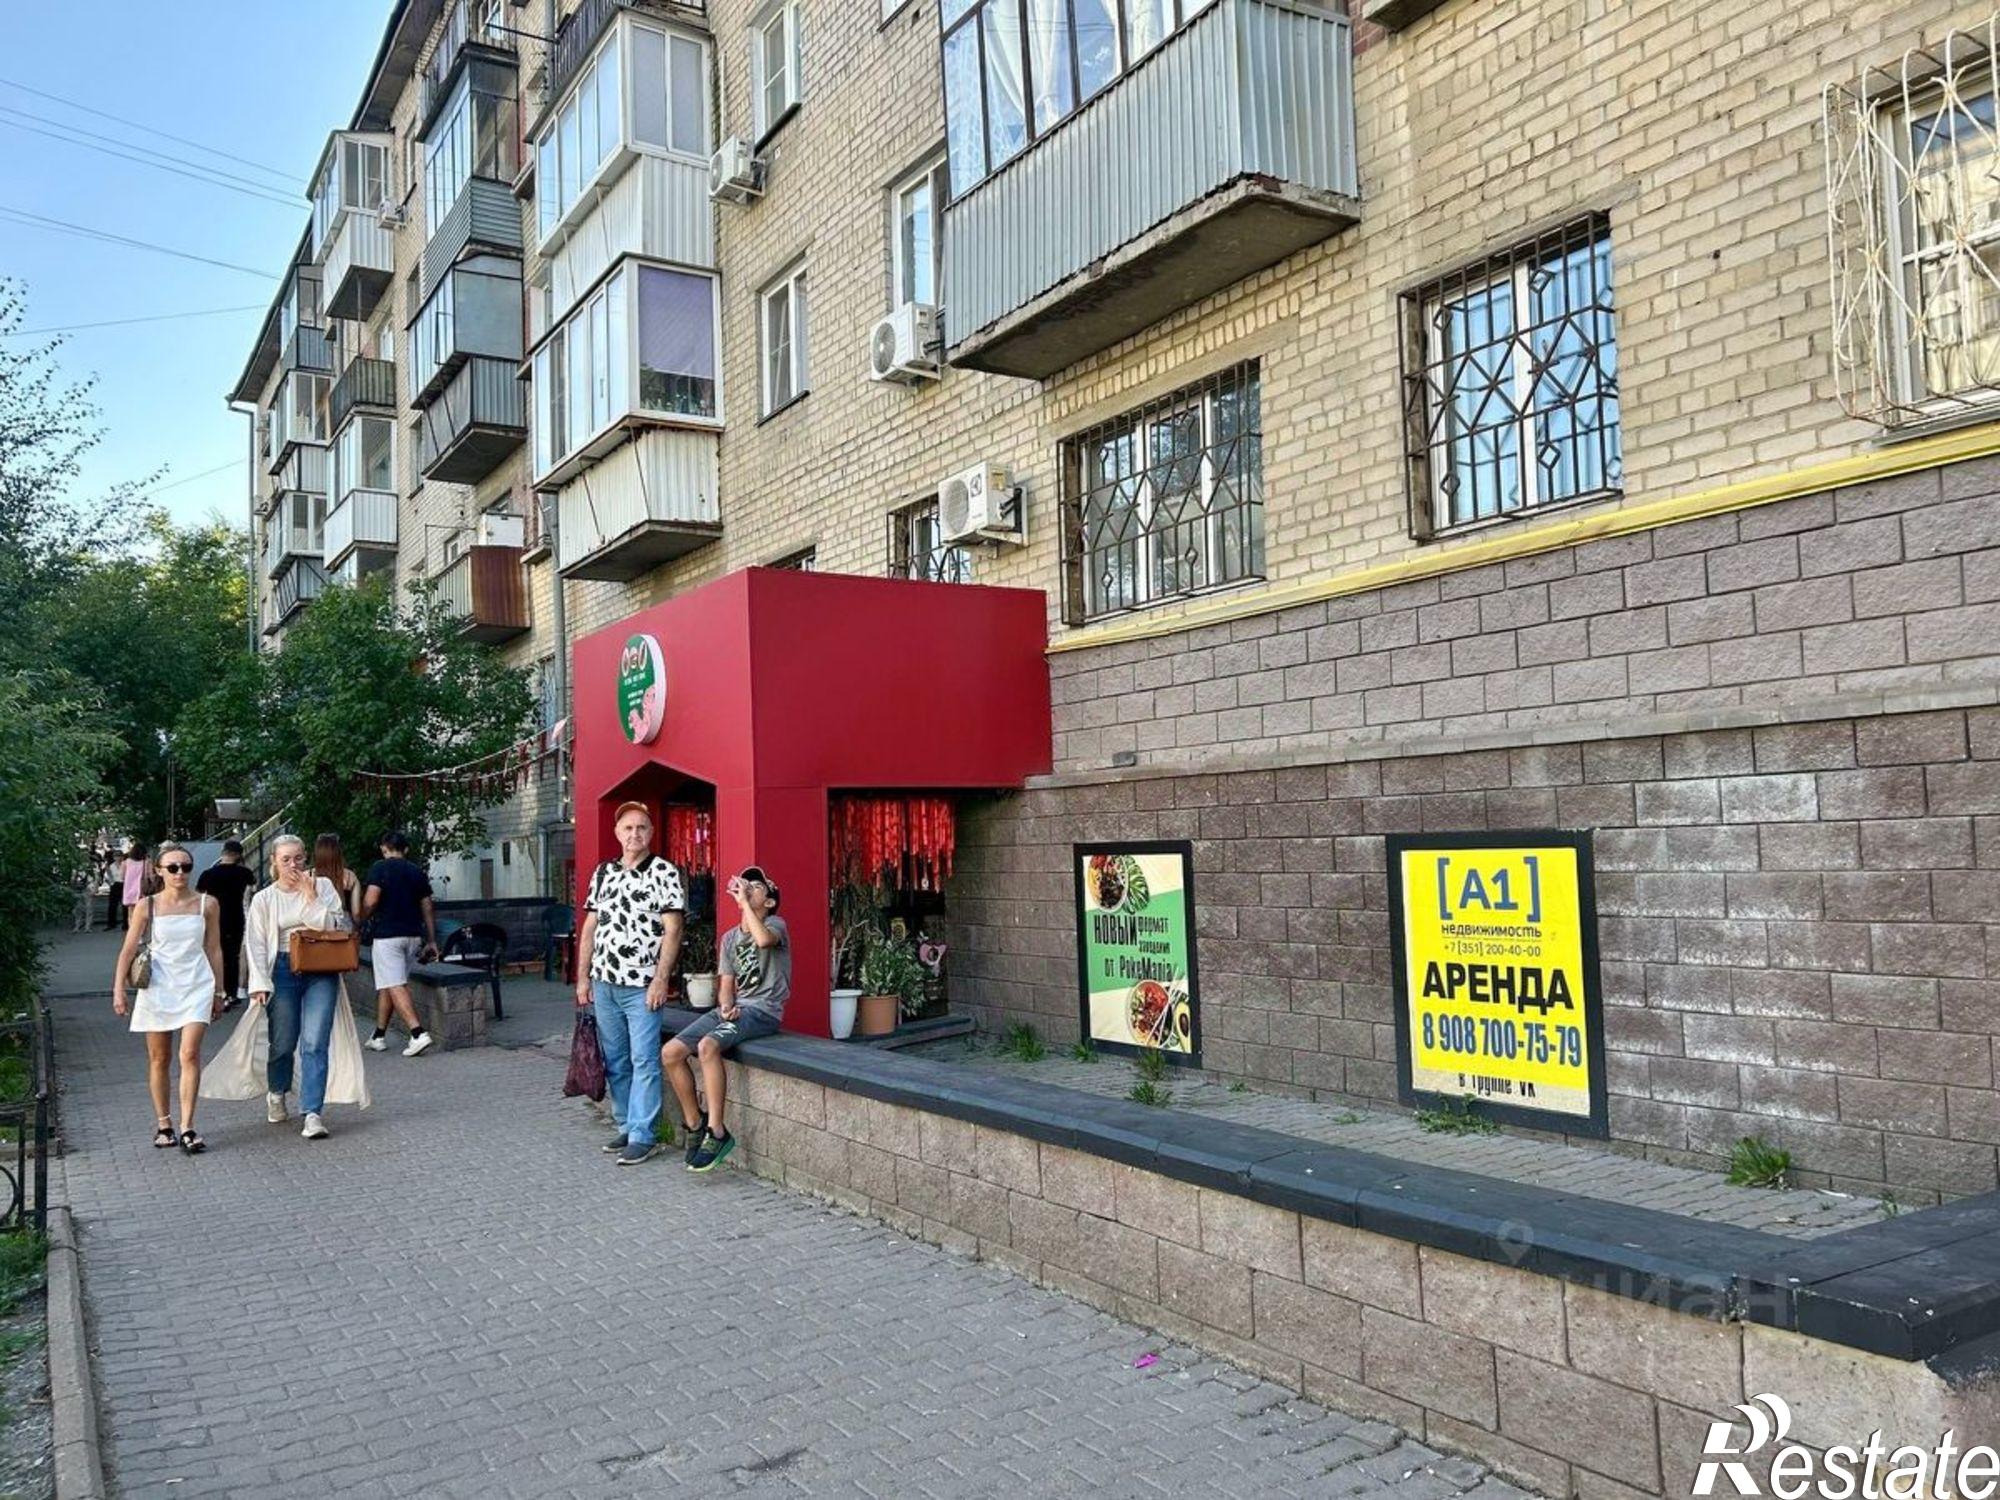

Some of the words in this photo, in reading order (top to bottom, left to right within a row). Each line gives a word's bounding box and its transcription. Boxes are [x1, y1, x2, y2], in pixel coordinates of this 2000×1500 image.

[1441, 924, 1542, 938] недвижимость
[1443, 941, 1456, 953] +7
[1486, 944, 1541, 957] 200-40-00
[1423, 961, 1574, 1016] АРЕНДА
[1422, 1011, 1435, 1050] 8
[1438, 1013, 1477, 1054] 908
[1479, 1017, 1582, 1068] 700-75-79
